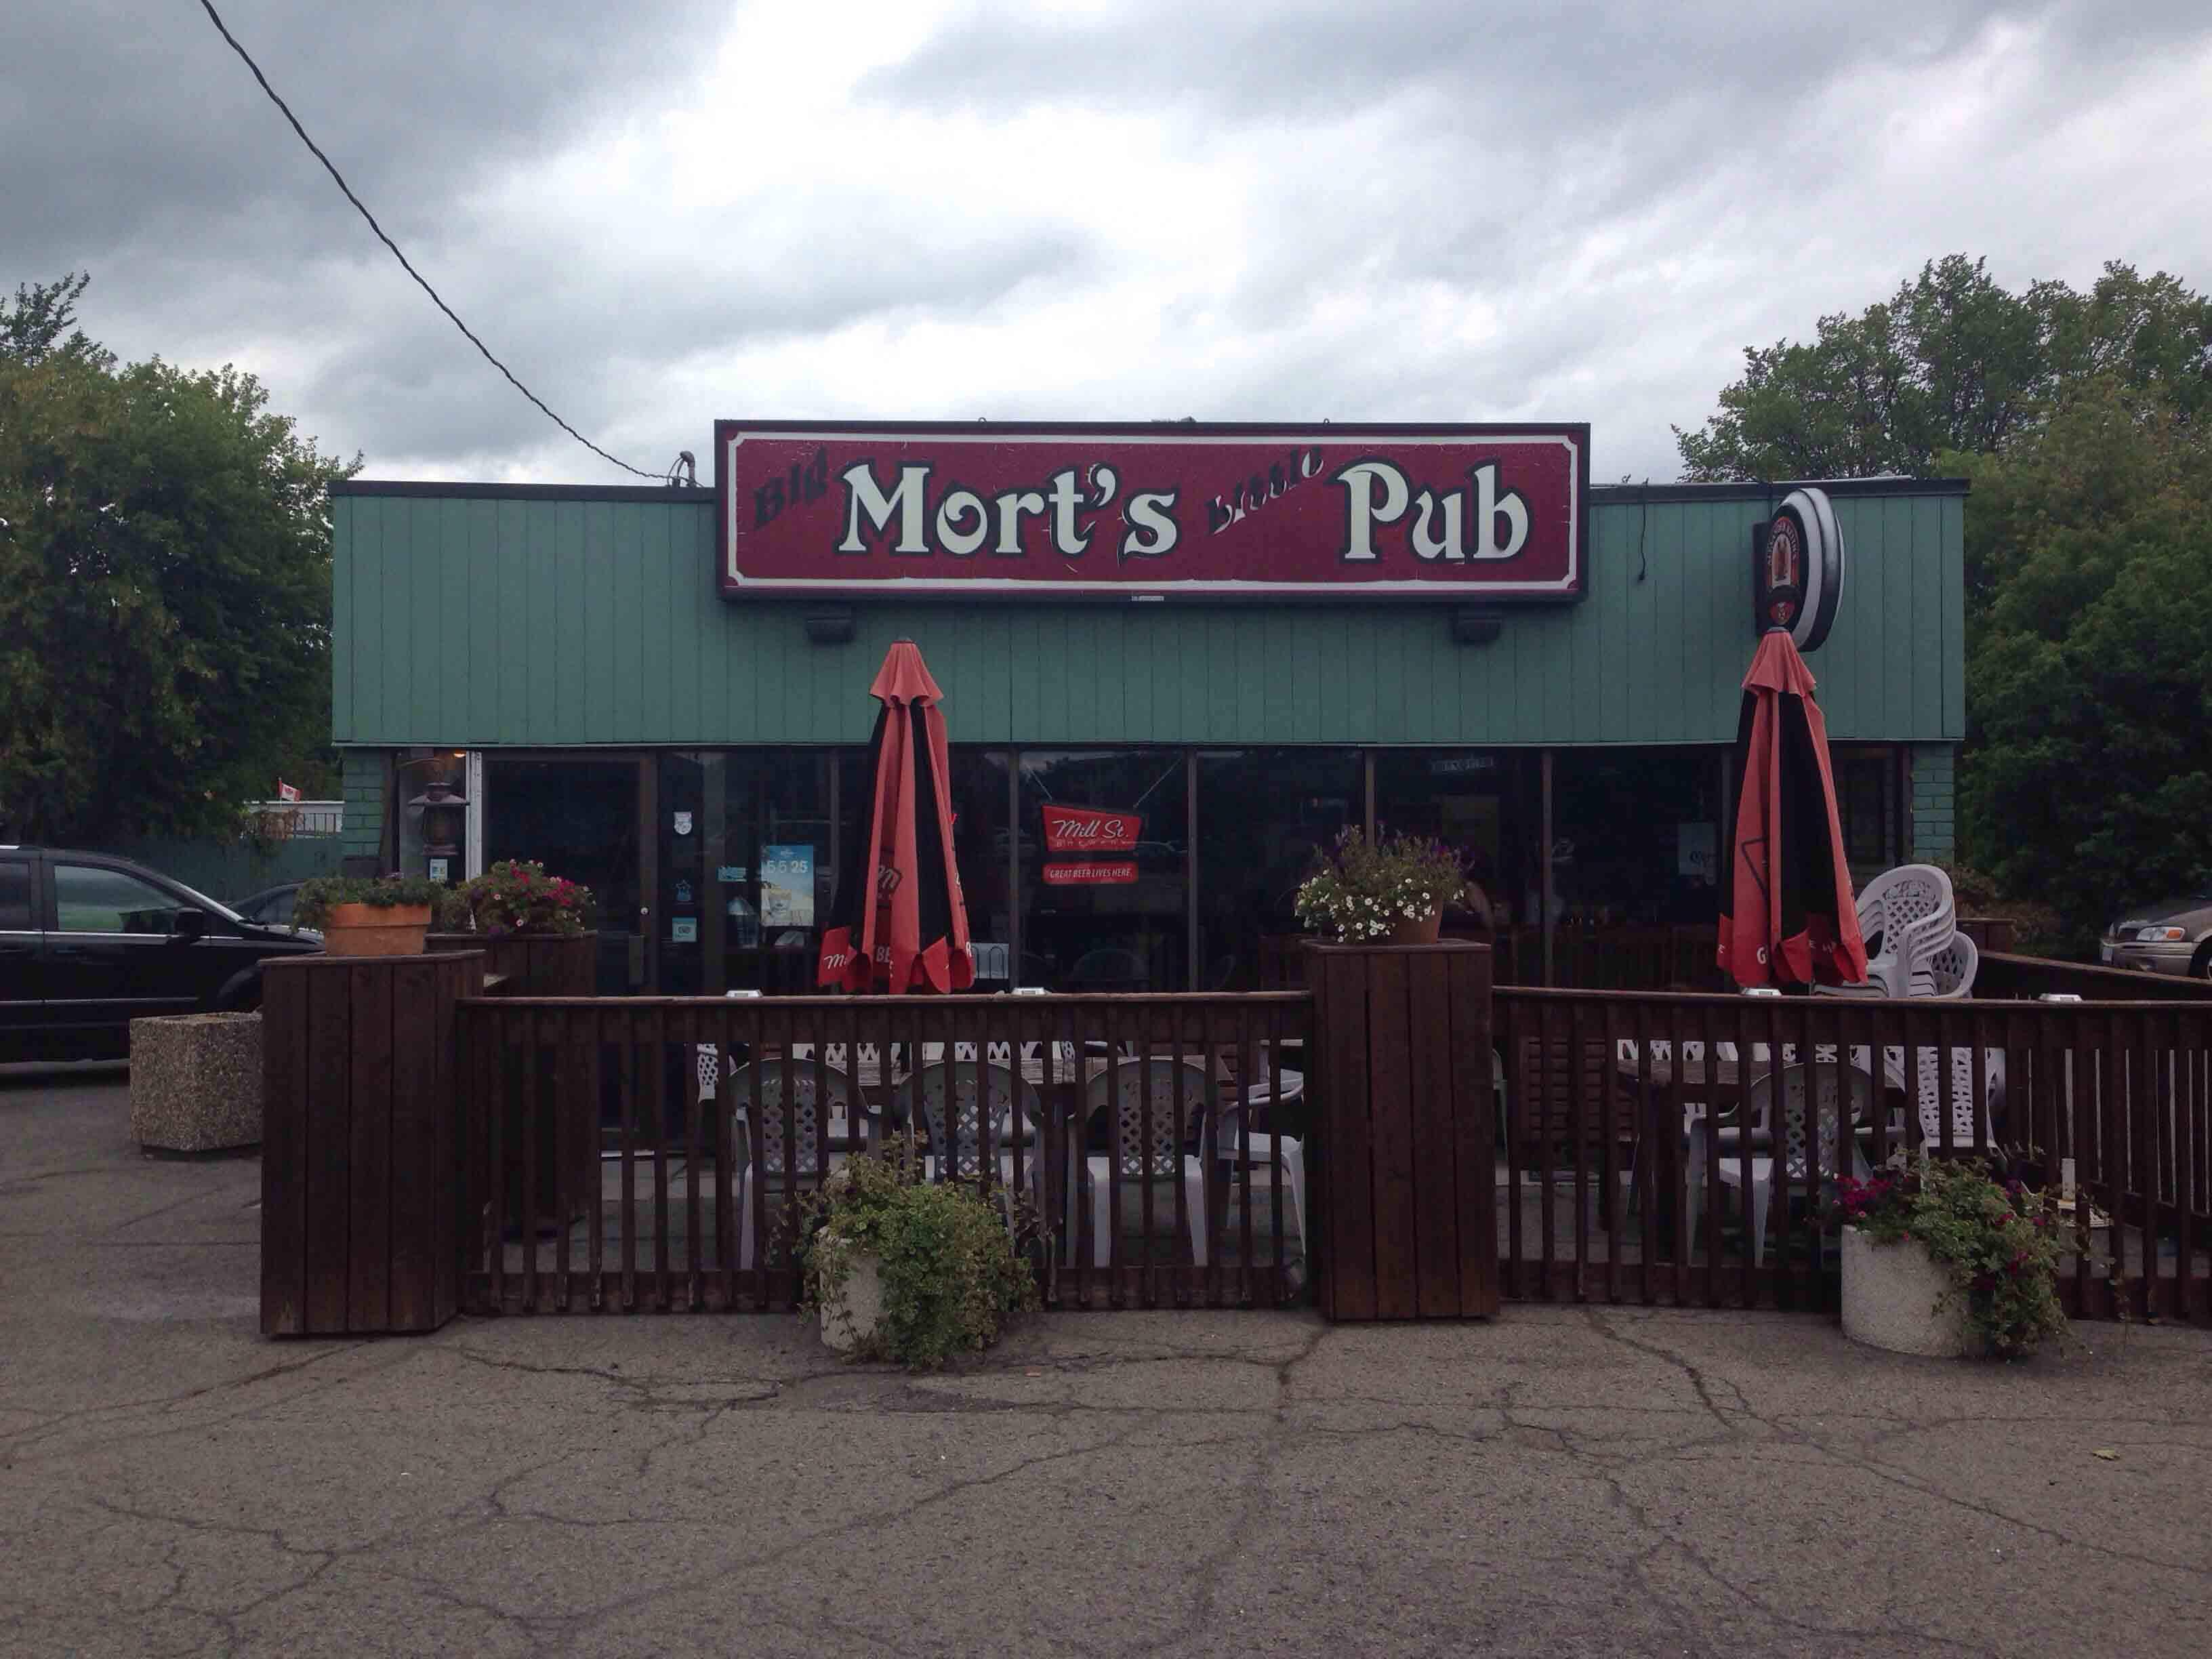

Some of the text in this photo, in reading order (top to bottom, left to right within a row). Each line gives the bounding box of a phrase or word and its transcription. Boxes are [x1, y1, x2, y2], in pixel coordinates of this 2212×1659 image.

[838, 461, 1178, 556] Mort's
[1337, 462, 1528, 559] Pub
[1052, 819, 1128, 838] Mill St.
[1050, 869, 1072, 878] GREAT
[1073, 868, 1090, 878] BEER
[1091, 868, 1111, 878] LIVES
